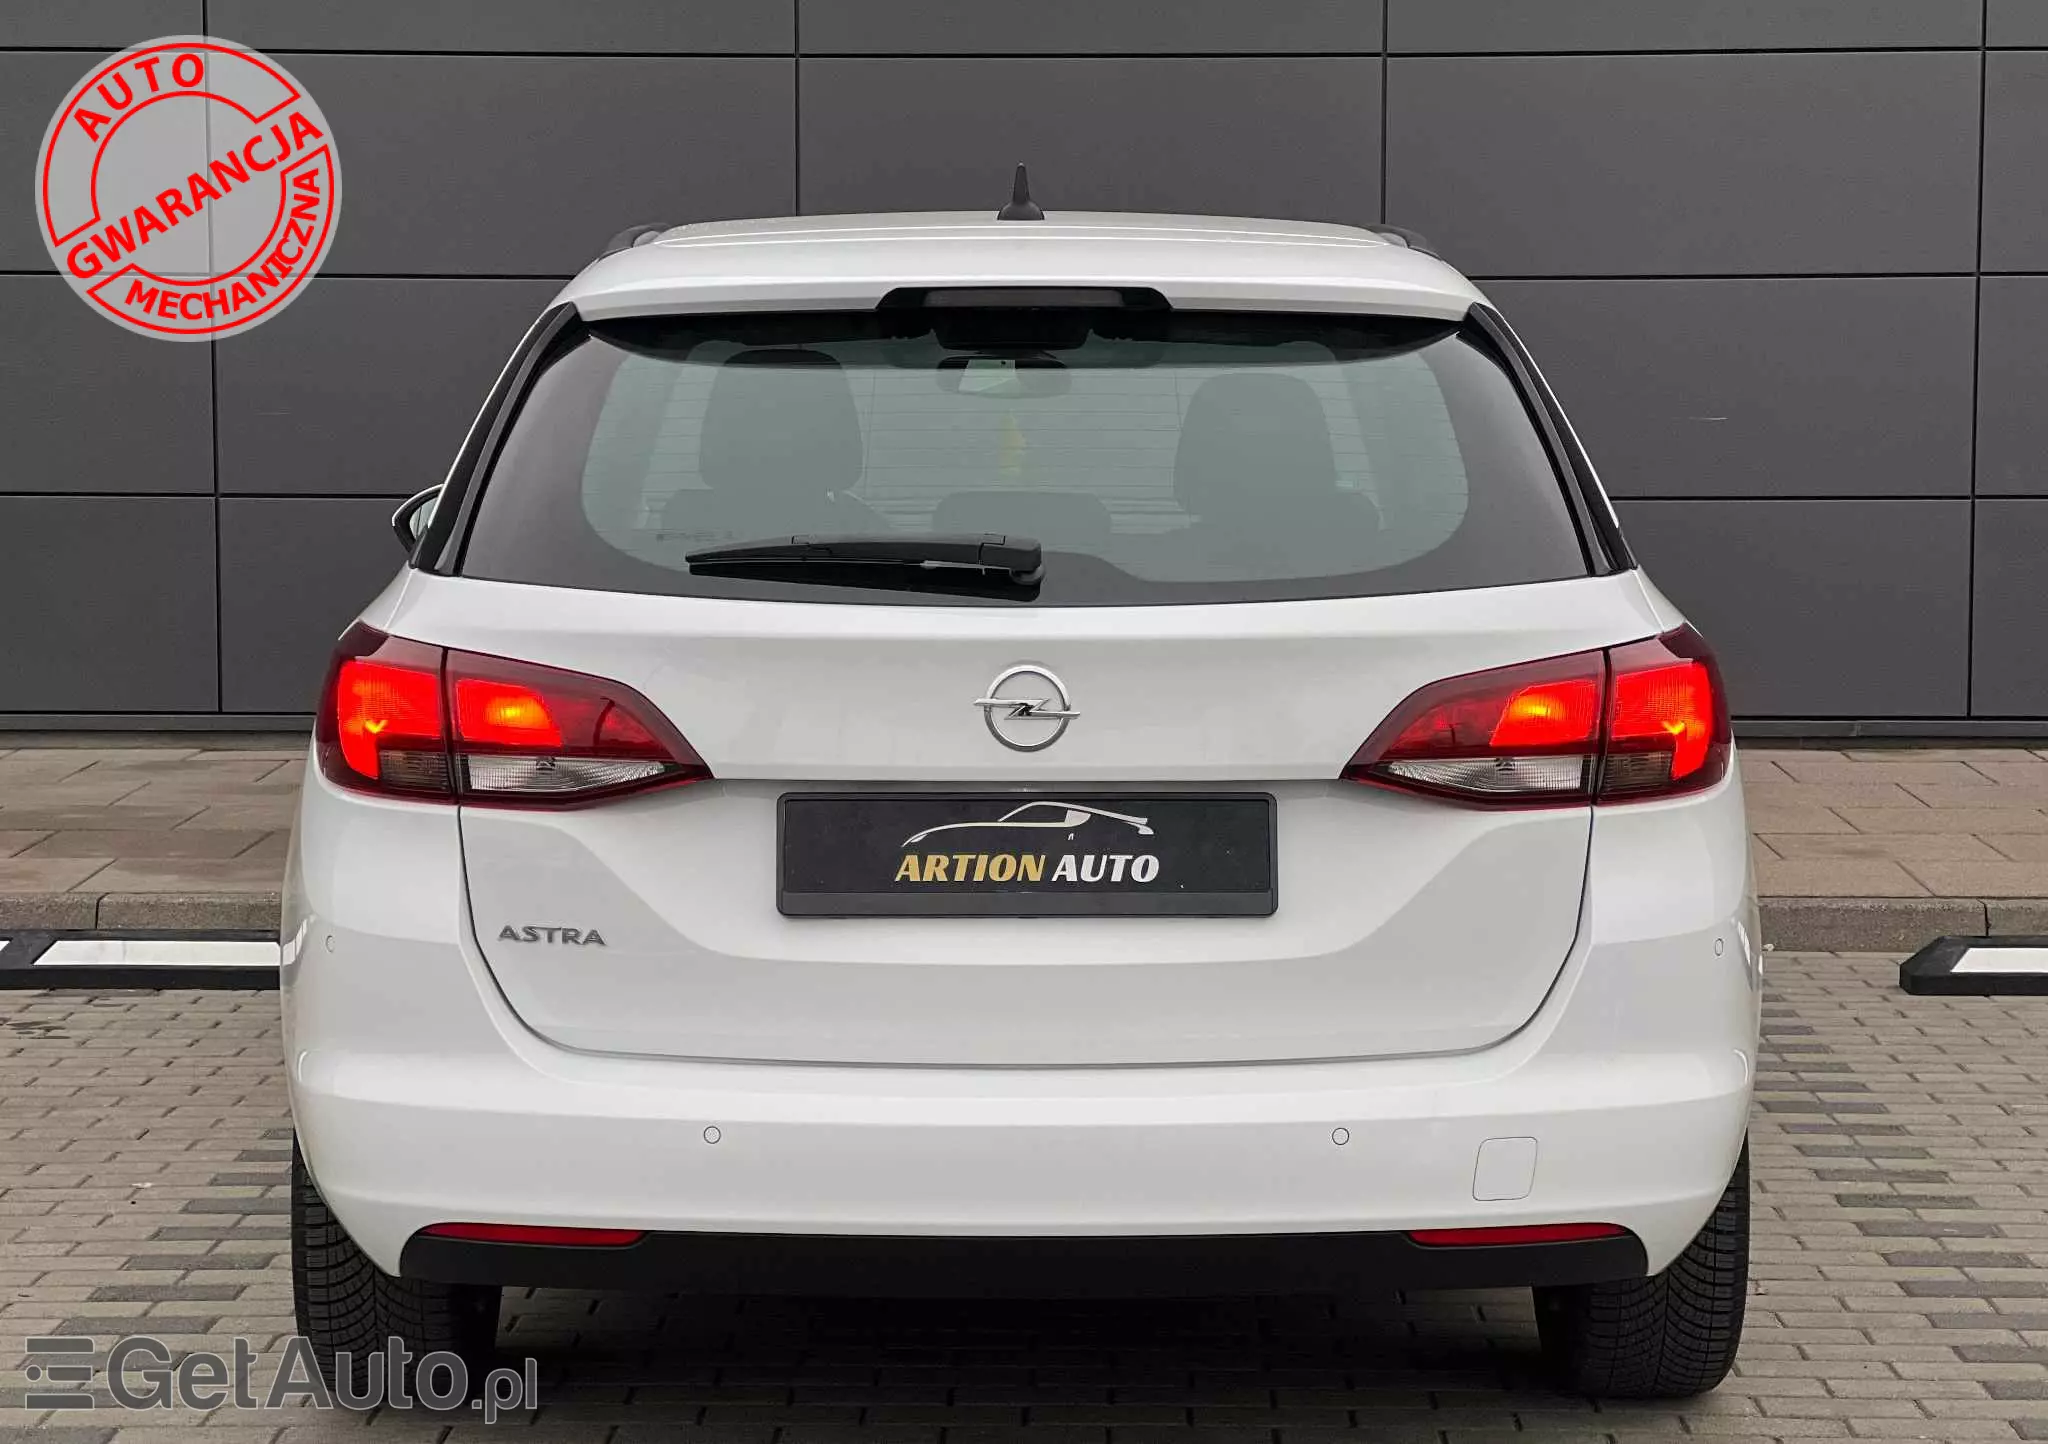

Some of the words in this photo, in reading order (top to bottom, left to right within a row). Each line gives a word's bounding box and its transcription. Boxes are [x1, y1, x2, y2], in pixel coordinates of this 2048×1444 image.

[894, 854, 1046, 882] ARTION
[1052, 854, 1160, 883] AUTO
[498, 925, 607, 946] ASTRA
